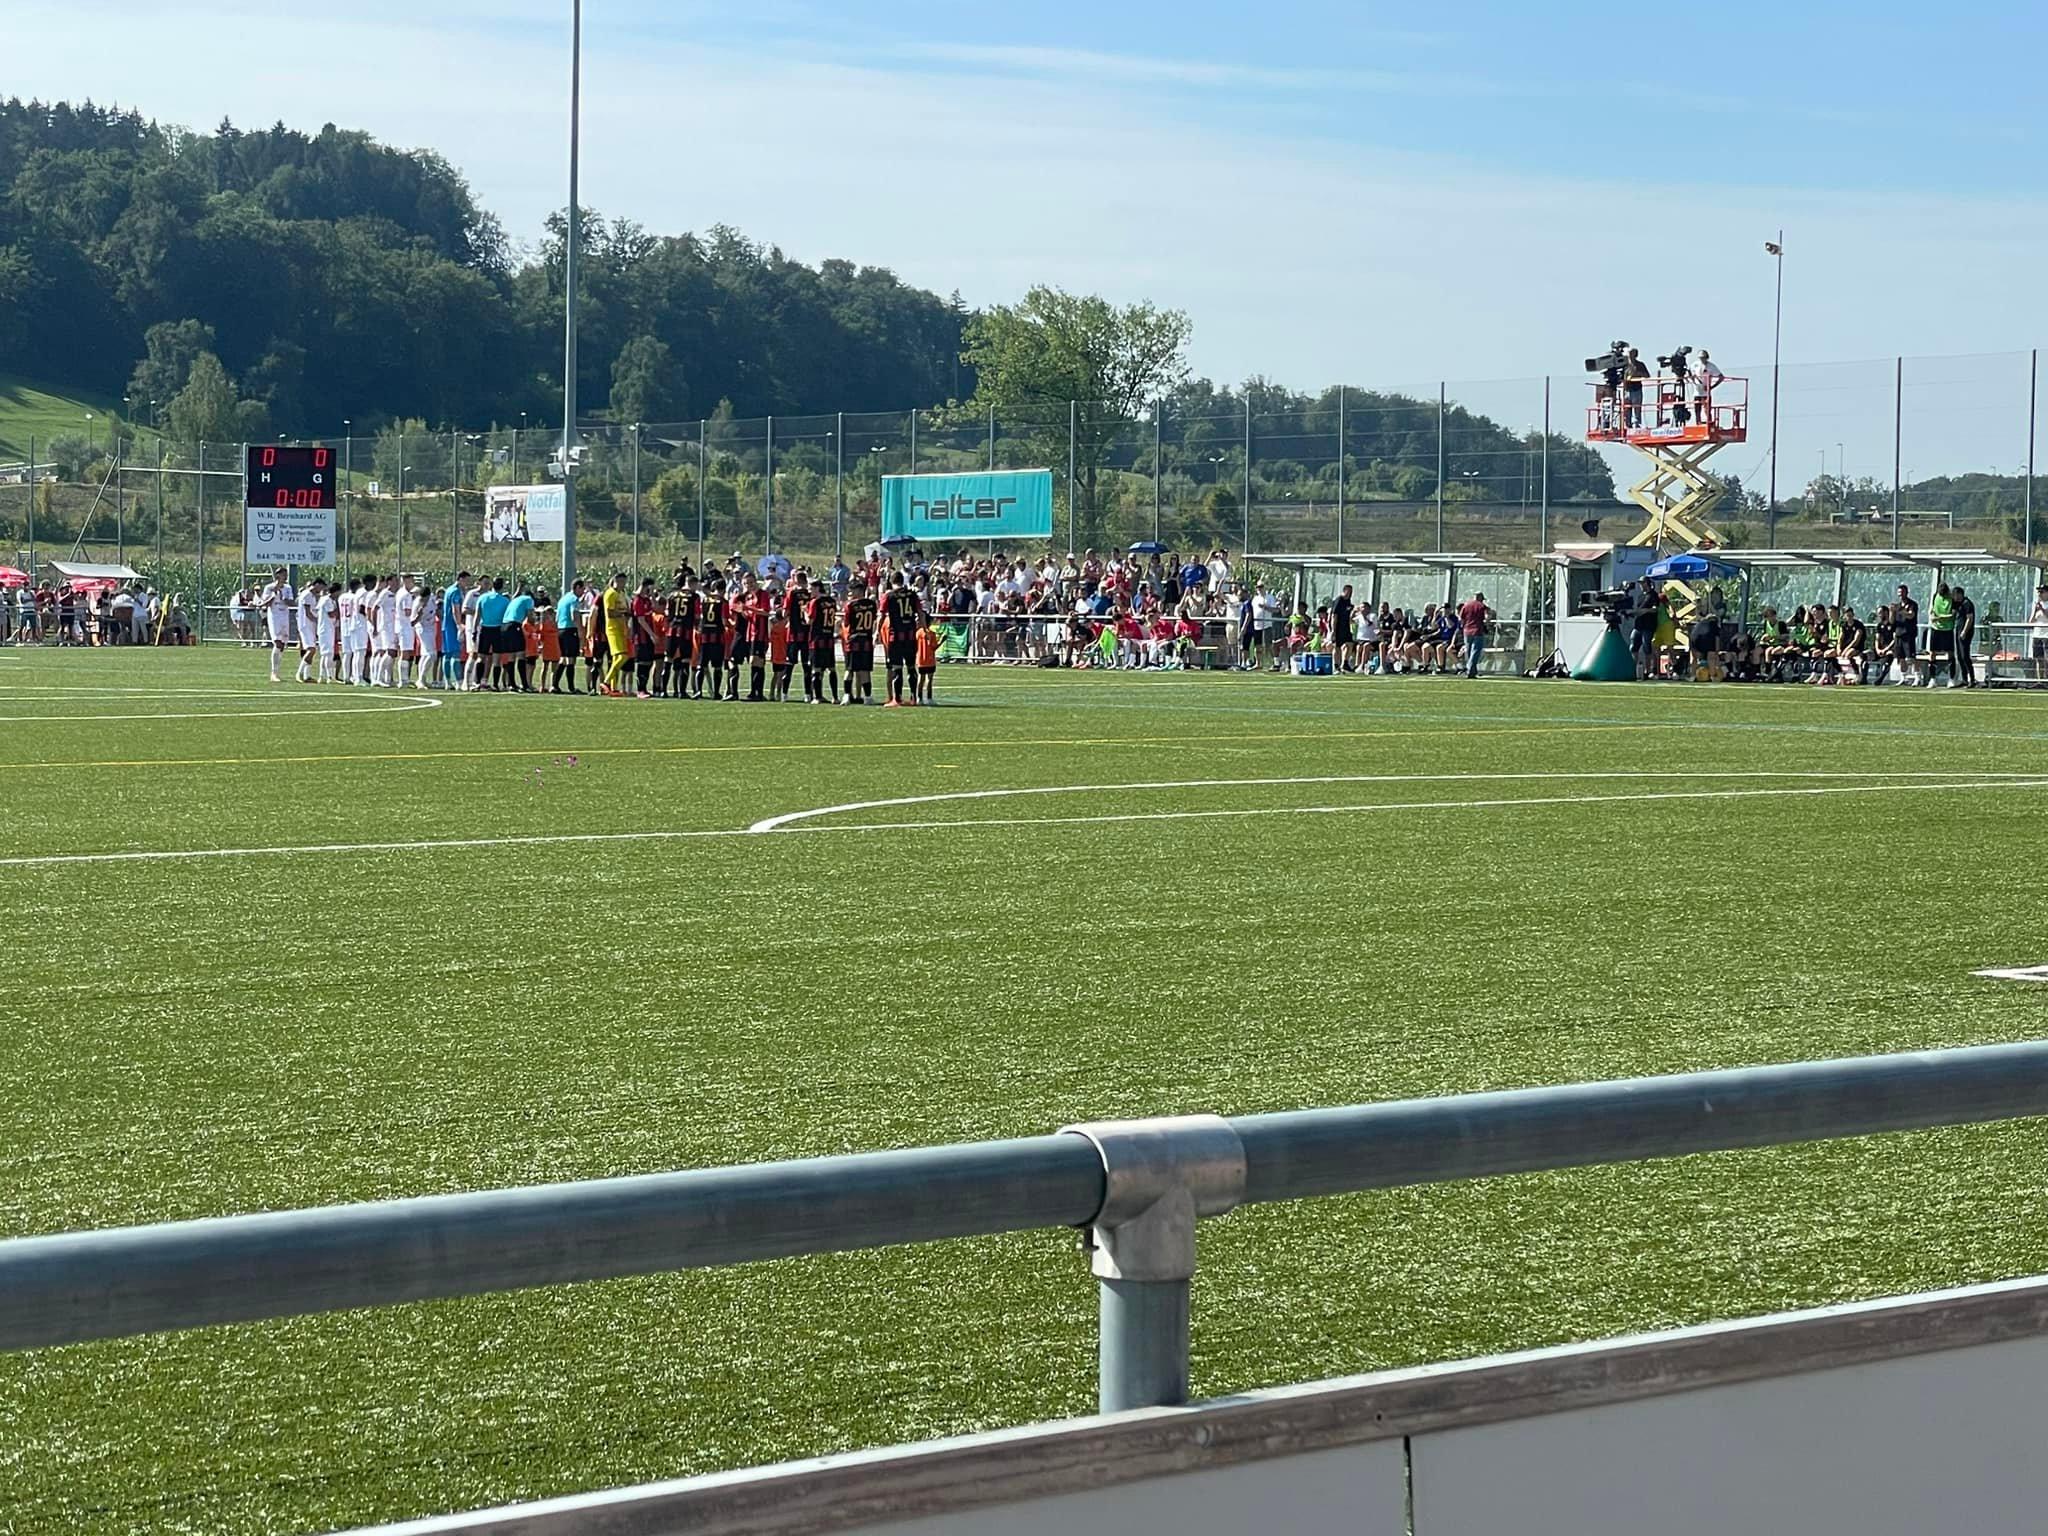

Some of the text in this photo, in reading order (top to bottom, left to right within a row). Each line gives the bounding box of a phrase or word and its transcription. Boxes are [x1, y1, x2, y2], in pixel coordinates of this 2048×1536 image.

[263, 448, 327, 467] 0 0
[261, 472, 323, 484] H G
[276, 489, 321, 507] 0:00
[910, 492, 1017, 521] halter
[314, 512, 327, 520] AG
[674, 597, 688, 616] 15
[707, 603, 715, 622] 6
[897, 597, 913, 618] 14
[822, 608, 835, 627] 13
[855, 610, 873, 631] 20
